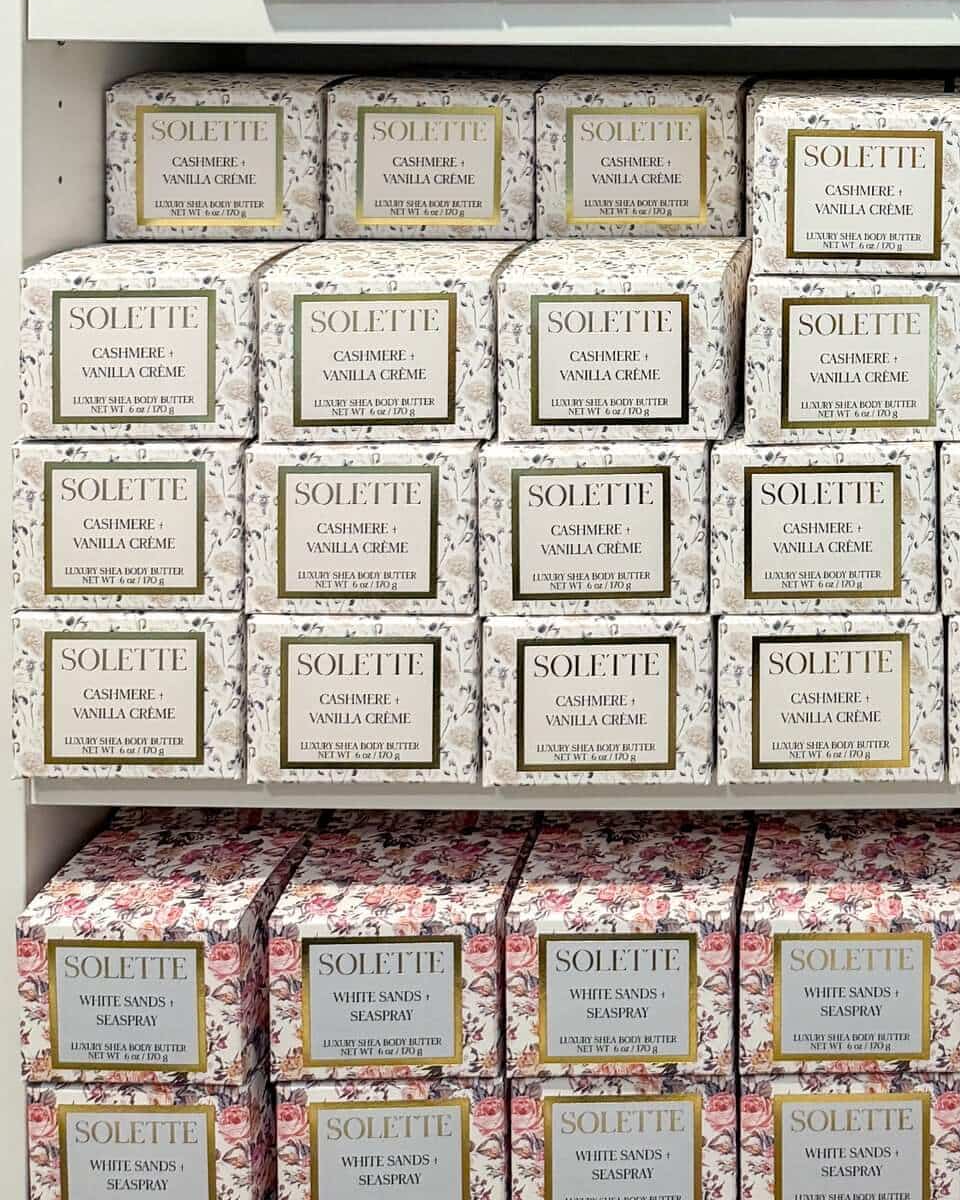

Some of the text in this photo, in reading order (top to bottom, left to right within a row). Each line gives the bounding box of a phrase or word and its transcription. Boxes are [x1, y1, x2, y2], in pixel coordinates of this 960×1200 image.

[152, 120, 268, 141] SOLETTE
[172, 156, 239, 167] CASHMERE
[804, 145, 925, 168] SOLETTE
[163, 174, 211, 184] VANILLA
[825, 184, 895, 196] CASHMERE
[154, 200, 185, 208] LUXURY
[210, 200, 231, 208] BODY
[234, 200, 264, 208] BUTTER
[815, 204, 866, 215] VANILLA
[806, 232, 838, 240] LUXURY
[295, 482, 421, 505] SOLETTE
[317, 522, 388, 534] CASHMERE
[306, 542, 359, 553] VANILLA
[769, 650, 893, 674] SOLETTE
[791, 692, 861, 704] CASHMERE
[781, 712, 832, 724] VANILLA
[64, 956, 187, 980] SOLETTE
[80, 995, 121, 1006] WHITE
[124, 996, 165, 1007] SANDS
[96, 1015, 158, 1026] SEASPRAY
[71, 1042, 186, 1052] LUXURY SHEA BODY BUTTER
[106, 1052, 120, 1060] WT
